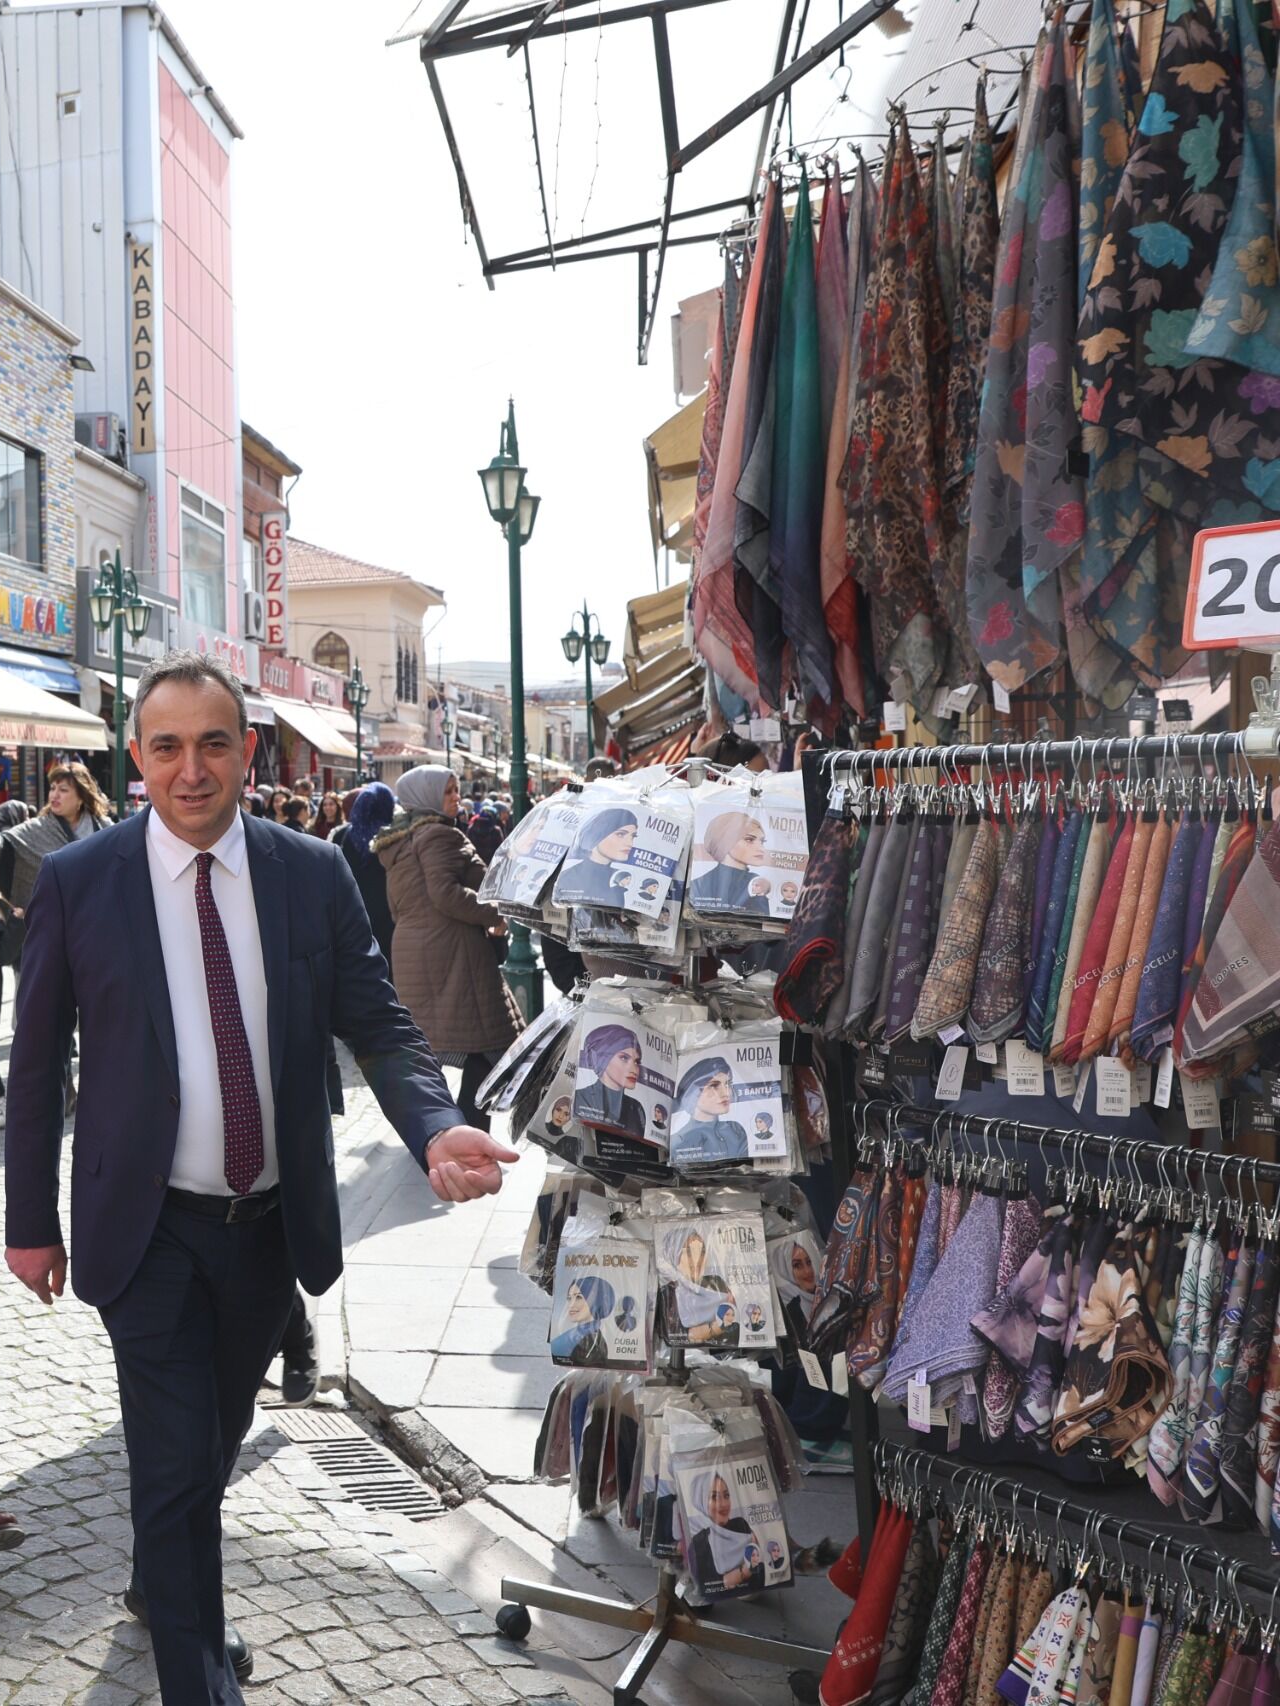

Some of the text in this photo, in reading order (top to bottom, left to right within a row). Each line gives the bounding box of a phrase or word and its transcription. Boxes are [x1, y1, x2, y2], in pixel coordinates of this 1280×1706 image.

[133, 247, 153, 447] KABADAYI
[263, 519, 285, 646] GÖZDE
[645, 815, 681, 839] MODA
[768, 815, 805, 834] MODA
[634, 858, 664, 874] MODEL
[645, 1030, 674, 1058] MODA
[736, 1046, 773, 1063] MODA
[718, 1226, 756, 1246] MODA
[602, 1254, 640, 1269] BONE
[615, 1346, 638, 1355] BONE
[735, 1464, 768, 1487] MODA
